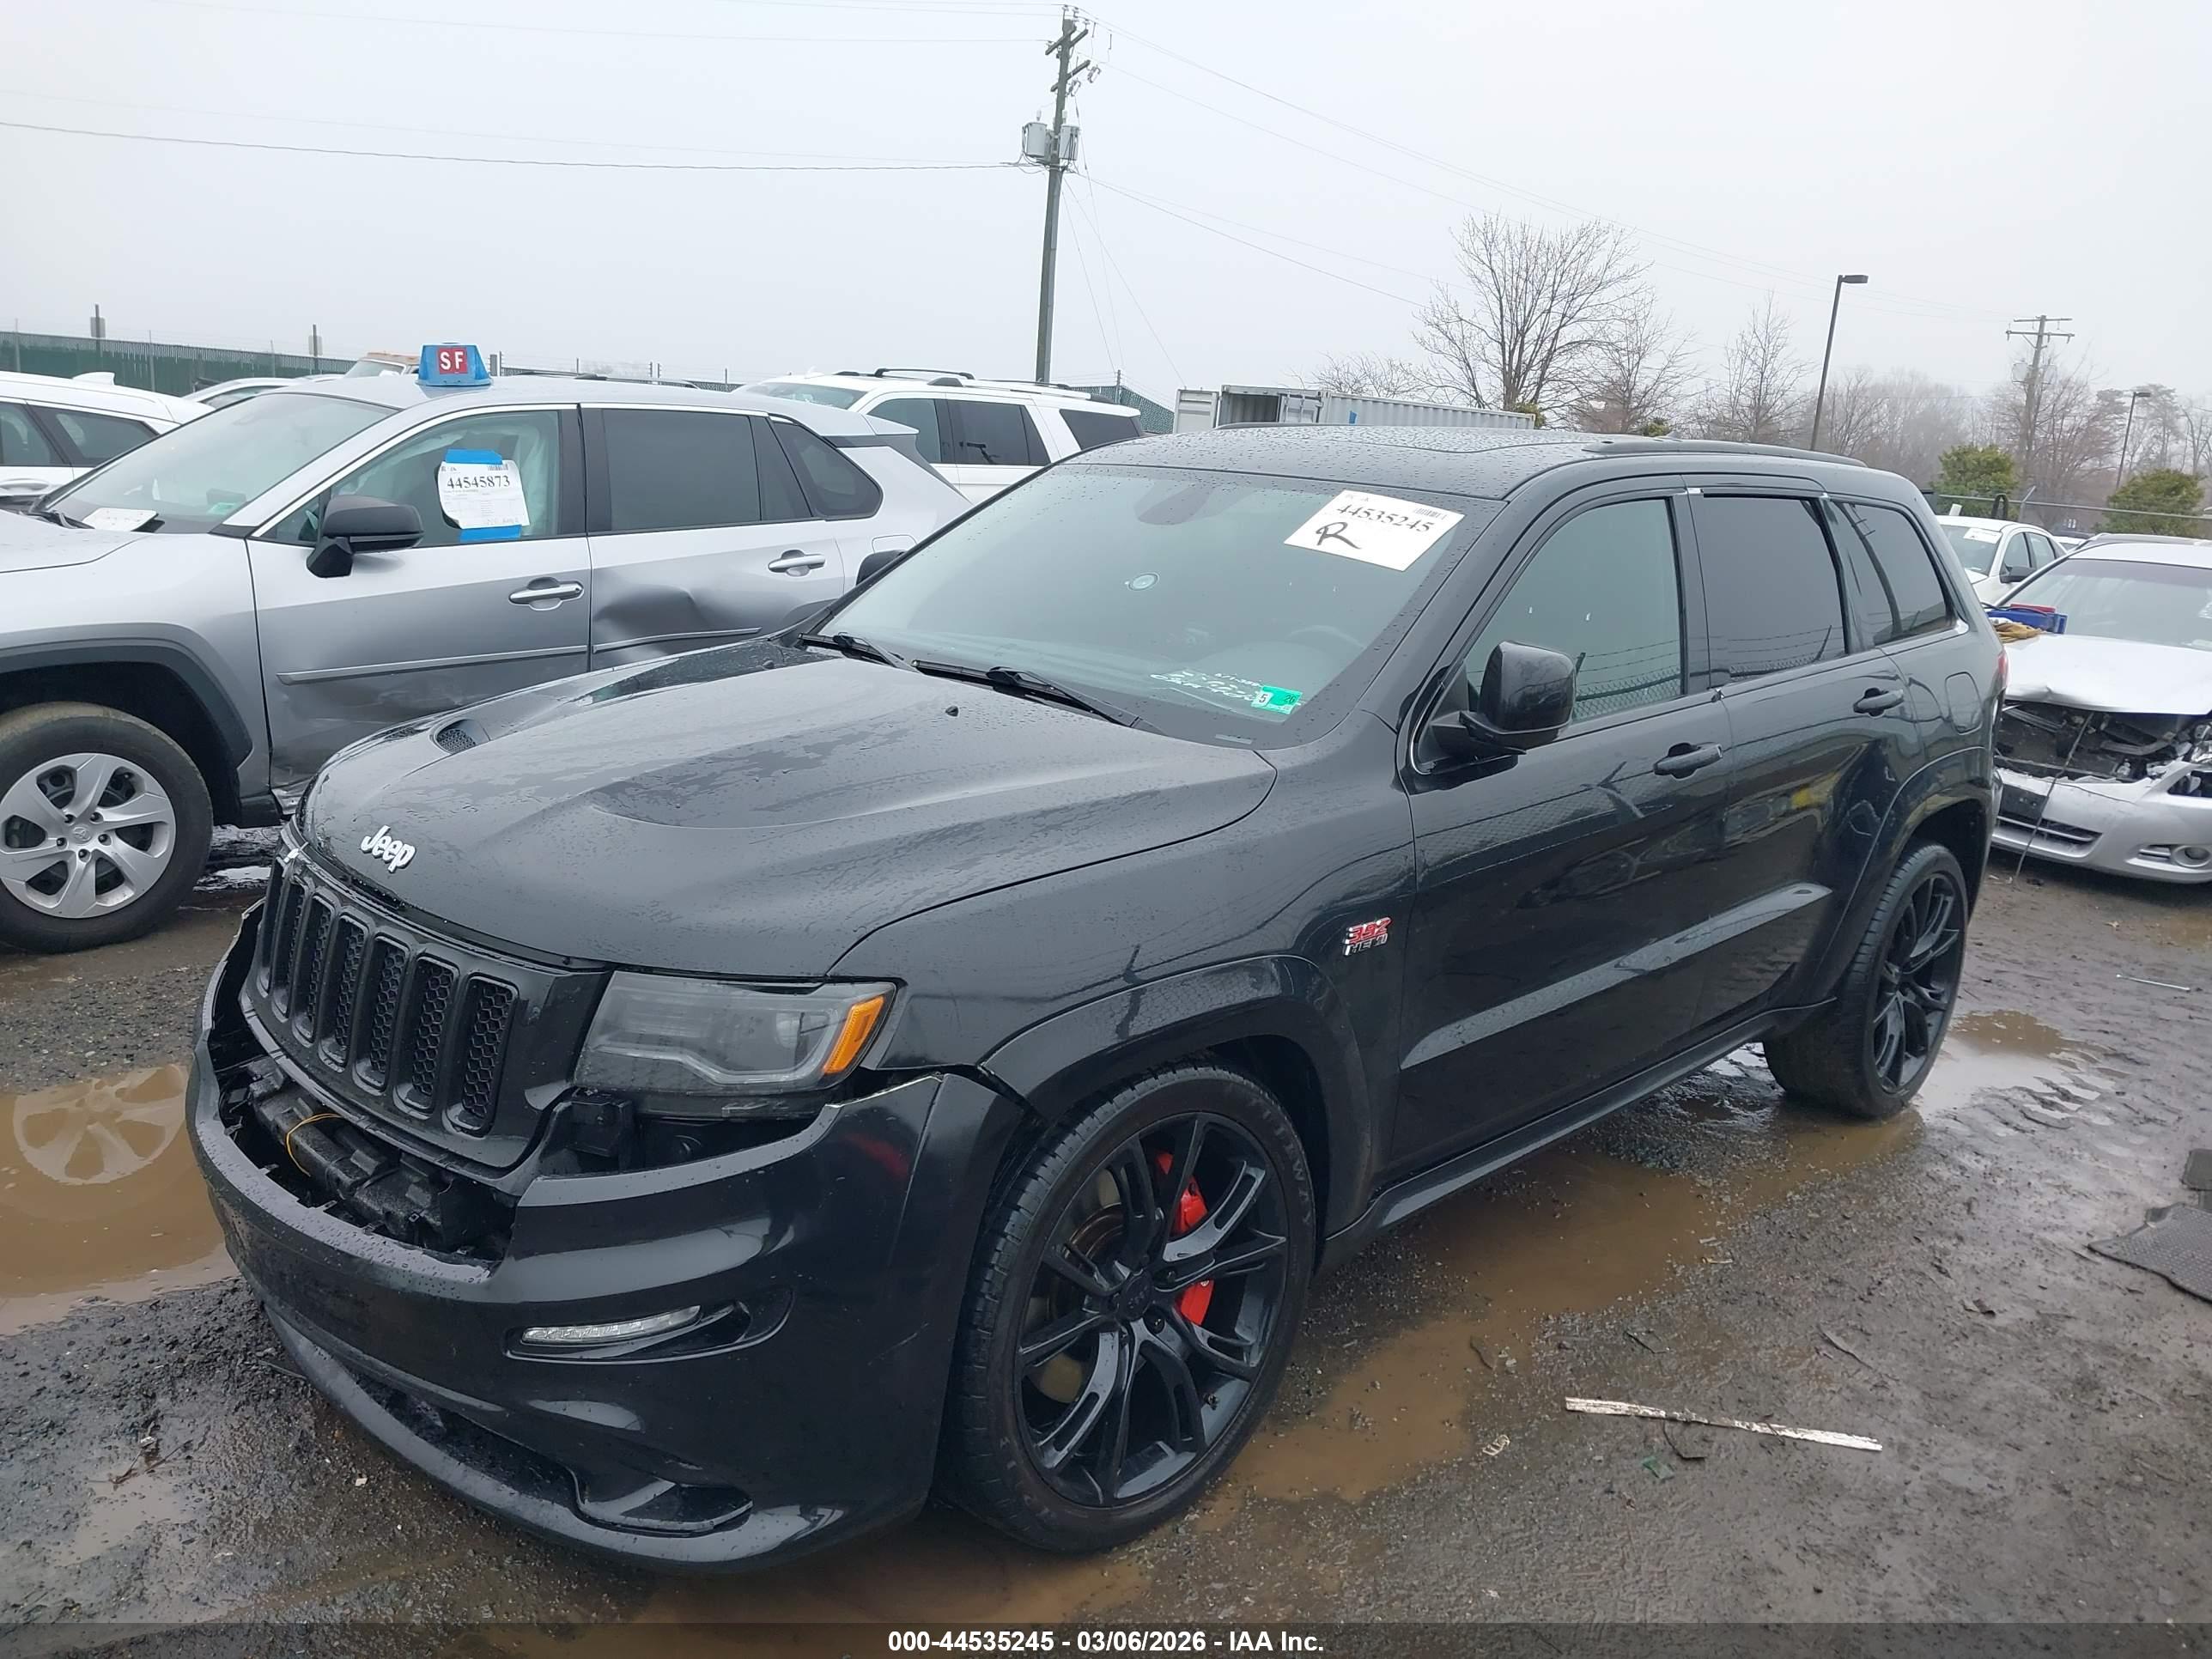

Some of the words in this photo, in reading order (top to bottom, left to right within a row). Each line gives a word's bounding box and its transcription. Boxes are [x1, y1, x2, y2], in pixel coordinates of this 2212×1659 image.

[440, 351, 464, 370] SF
[447, 475, 511, 489] 44545873
[1336, 504, 1436, 532] 44535245
[1316, 521, 1362, 550] R
[1259, 694, 1268, 703] 5
[361, 825, 416, 873] Jeep
[1346, 916, 1392, 945] 392
